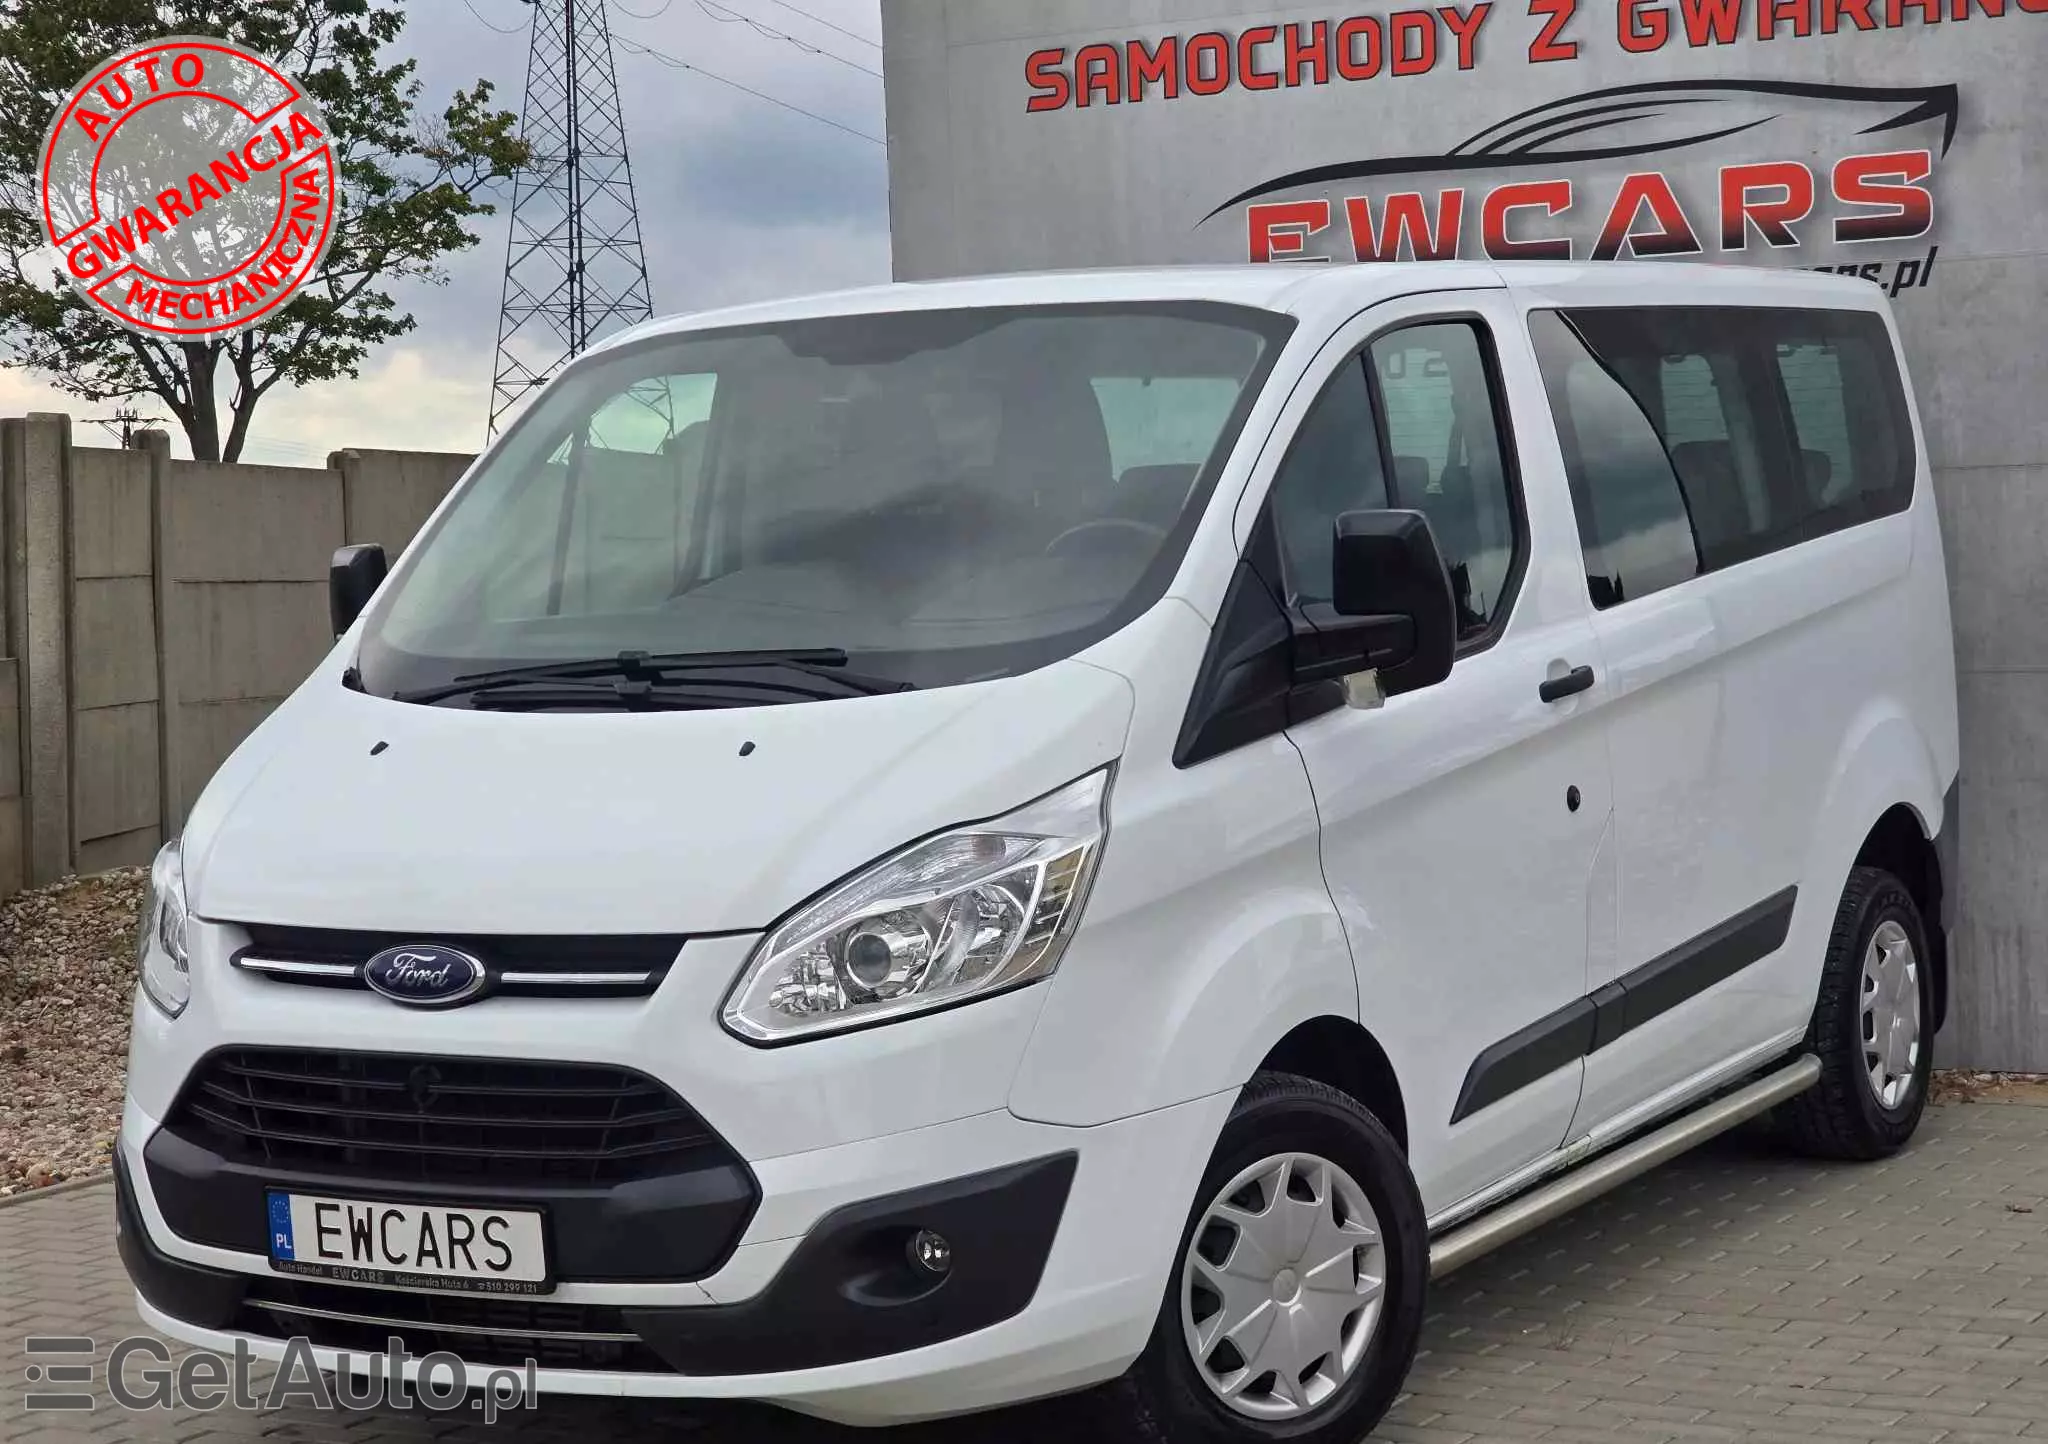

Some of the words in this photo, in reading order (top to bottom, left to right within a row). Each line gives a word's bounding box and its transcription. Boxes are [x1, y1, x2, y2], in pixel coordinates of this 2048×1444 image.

[1025, 4, 1489, 113] SAMOCHODY
[1528, 0, 1578, 63] Z
[1246, 149, 1935, 263] EWCARS
[385, 952, 452, 988] Ford
[275, 1232, 292, 1250] PL
[314, 1201, 513, 1272] EWCARS
[332, 1266, 385, 1283] EWCARS
